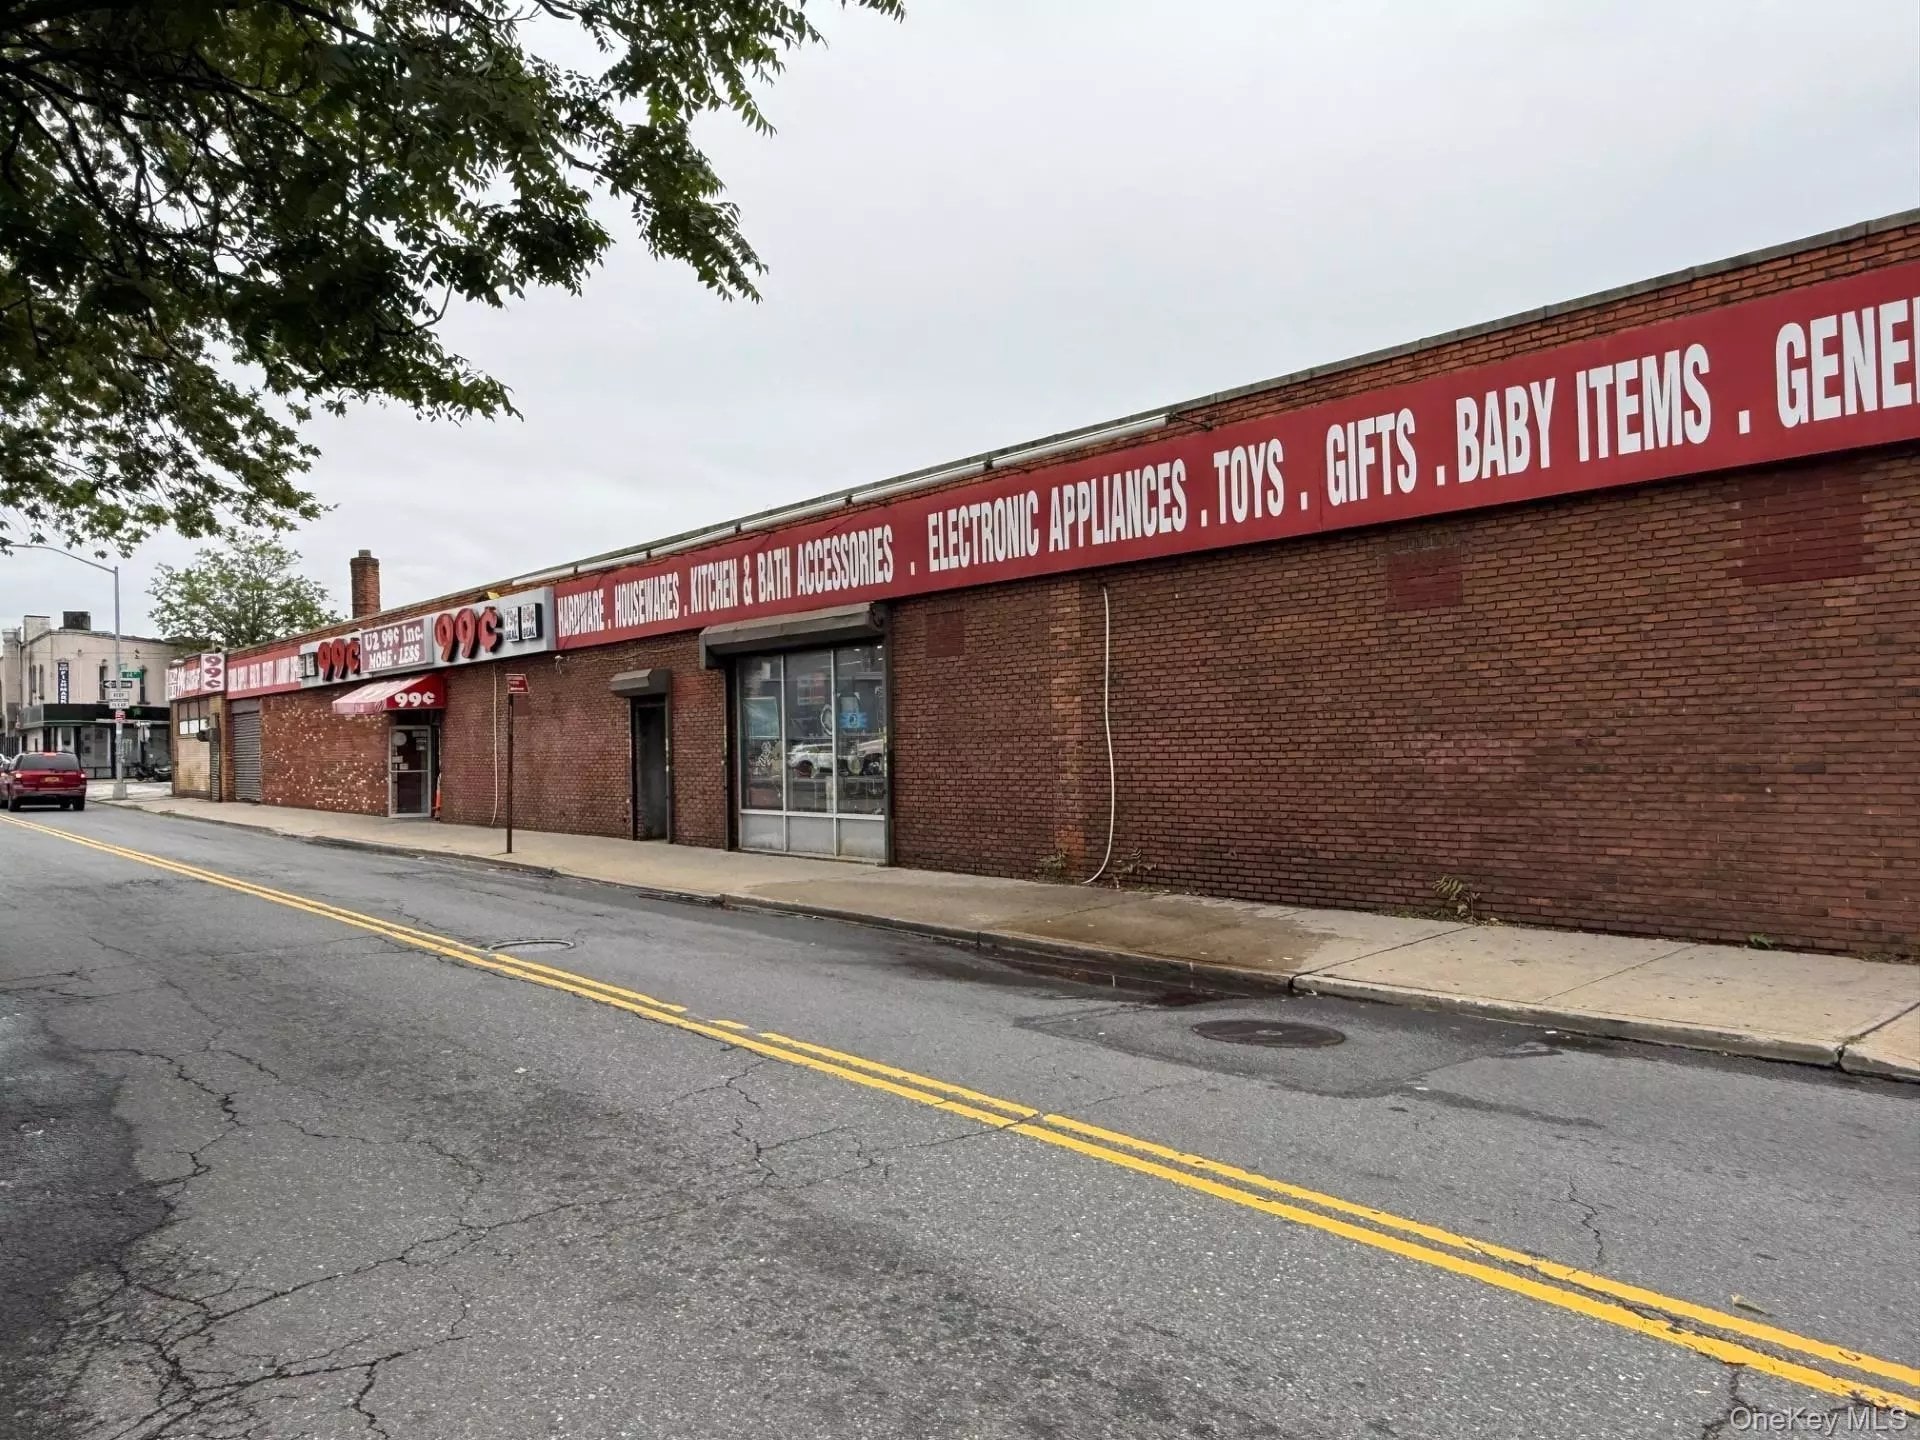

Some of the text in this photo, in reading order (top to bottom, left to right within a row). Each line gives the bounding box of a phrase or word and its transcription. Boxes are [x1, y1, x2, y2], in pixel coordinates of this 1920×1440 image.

[558, 588, 605, 637] HARDWARE
[614, 571, 680, 628] HOUSEWARES
[690, 558, 739, 613] KITCHEN
[743, 554, 753, 606] &
[757, 546, 792, 603] BATH
[796, 524, 894, 596] ACCESSORIES
[927, 490, 1040, 573] ELECTRONIC
[1048, 458, 1187, 553] APPLIANCES
[1213, 438, 1285, 524] TOYS
[1326, 407, 1417, 506] GIFTS
[1455, 377, 1556, 483] BABY
[1576, 343, 1712, 462] ITEMS
[365, 632, 380, 651] U2
[369, 644, 420, 668] MORE LESS
[395, 690, 435, 707] 99¢
